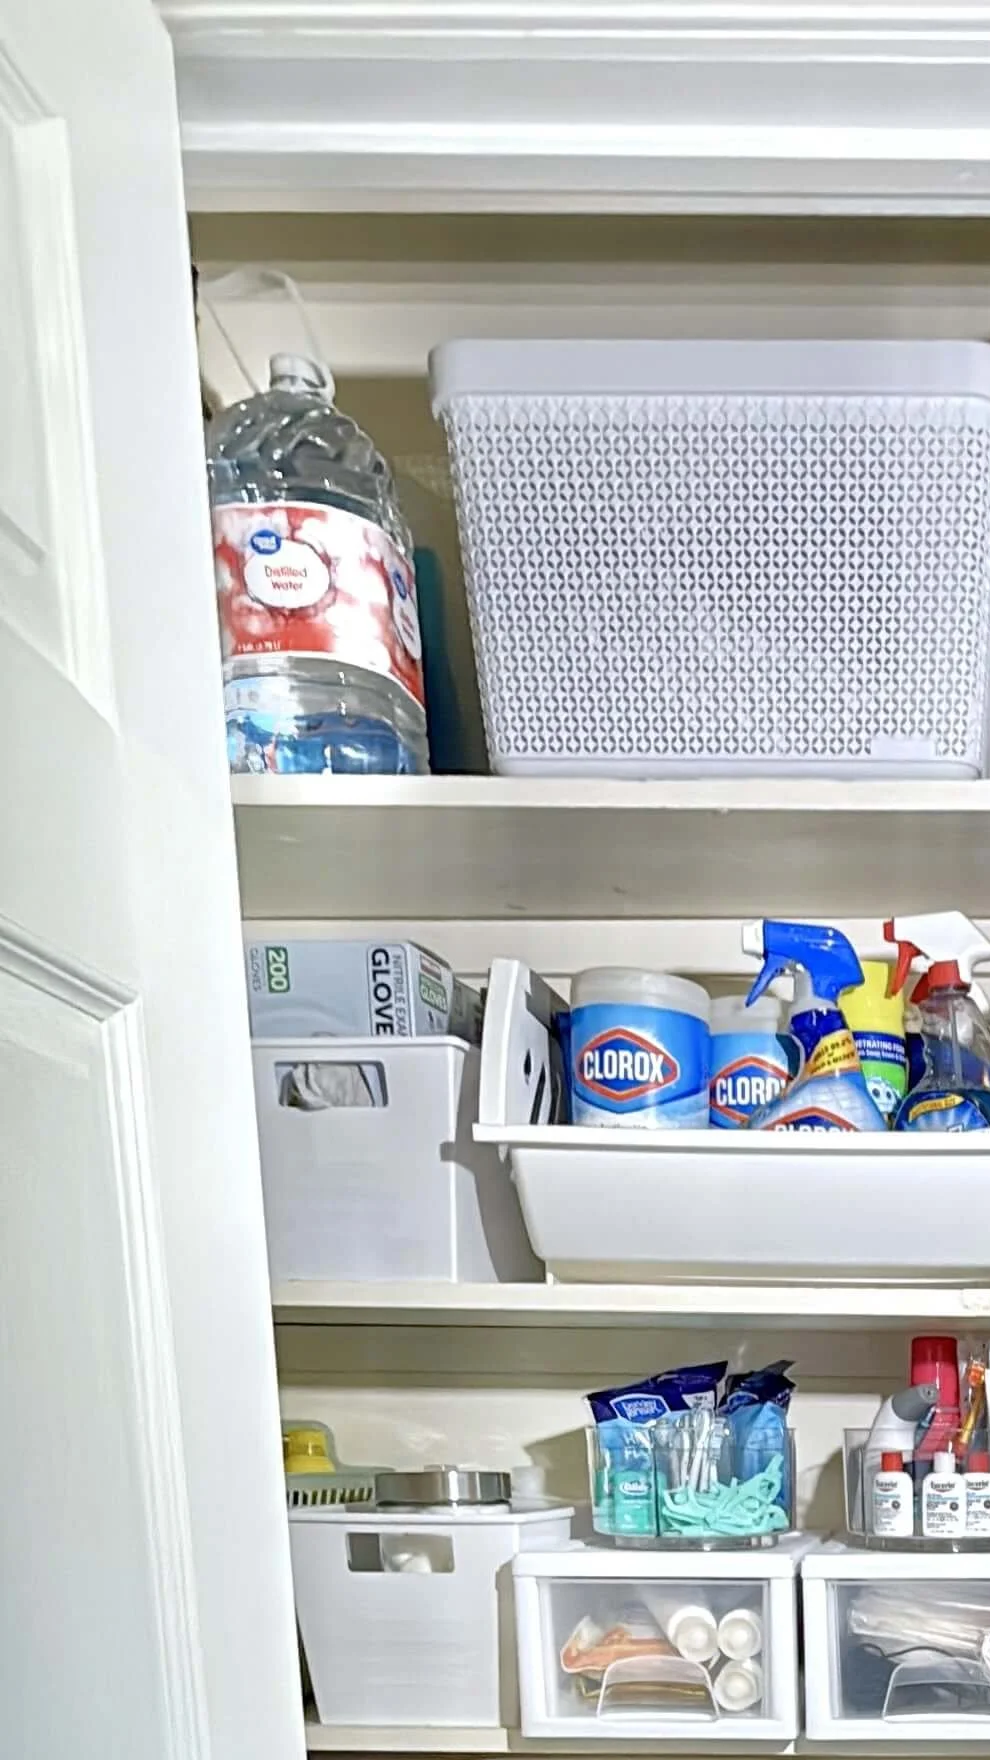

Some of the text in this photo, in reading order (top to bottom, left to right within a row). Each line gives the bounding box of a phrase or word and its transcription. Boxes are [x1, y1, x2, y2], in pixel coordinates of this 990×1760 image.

[264, 565, 307, 578] Distilled
[271, 581, 303, 591] Water
[269, 949, 288, 991] 200
[393, 954, 406, 1005] NITRILE
[371, 948, 394, 1035] GLOVE
[583, 1049, 664, 1083] CLOROX
[716, 1076, 786, 1106] CLORO
